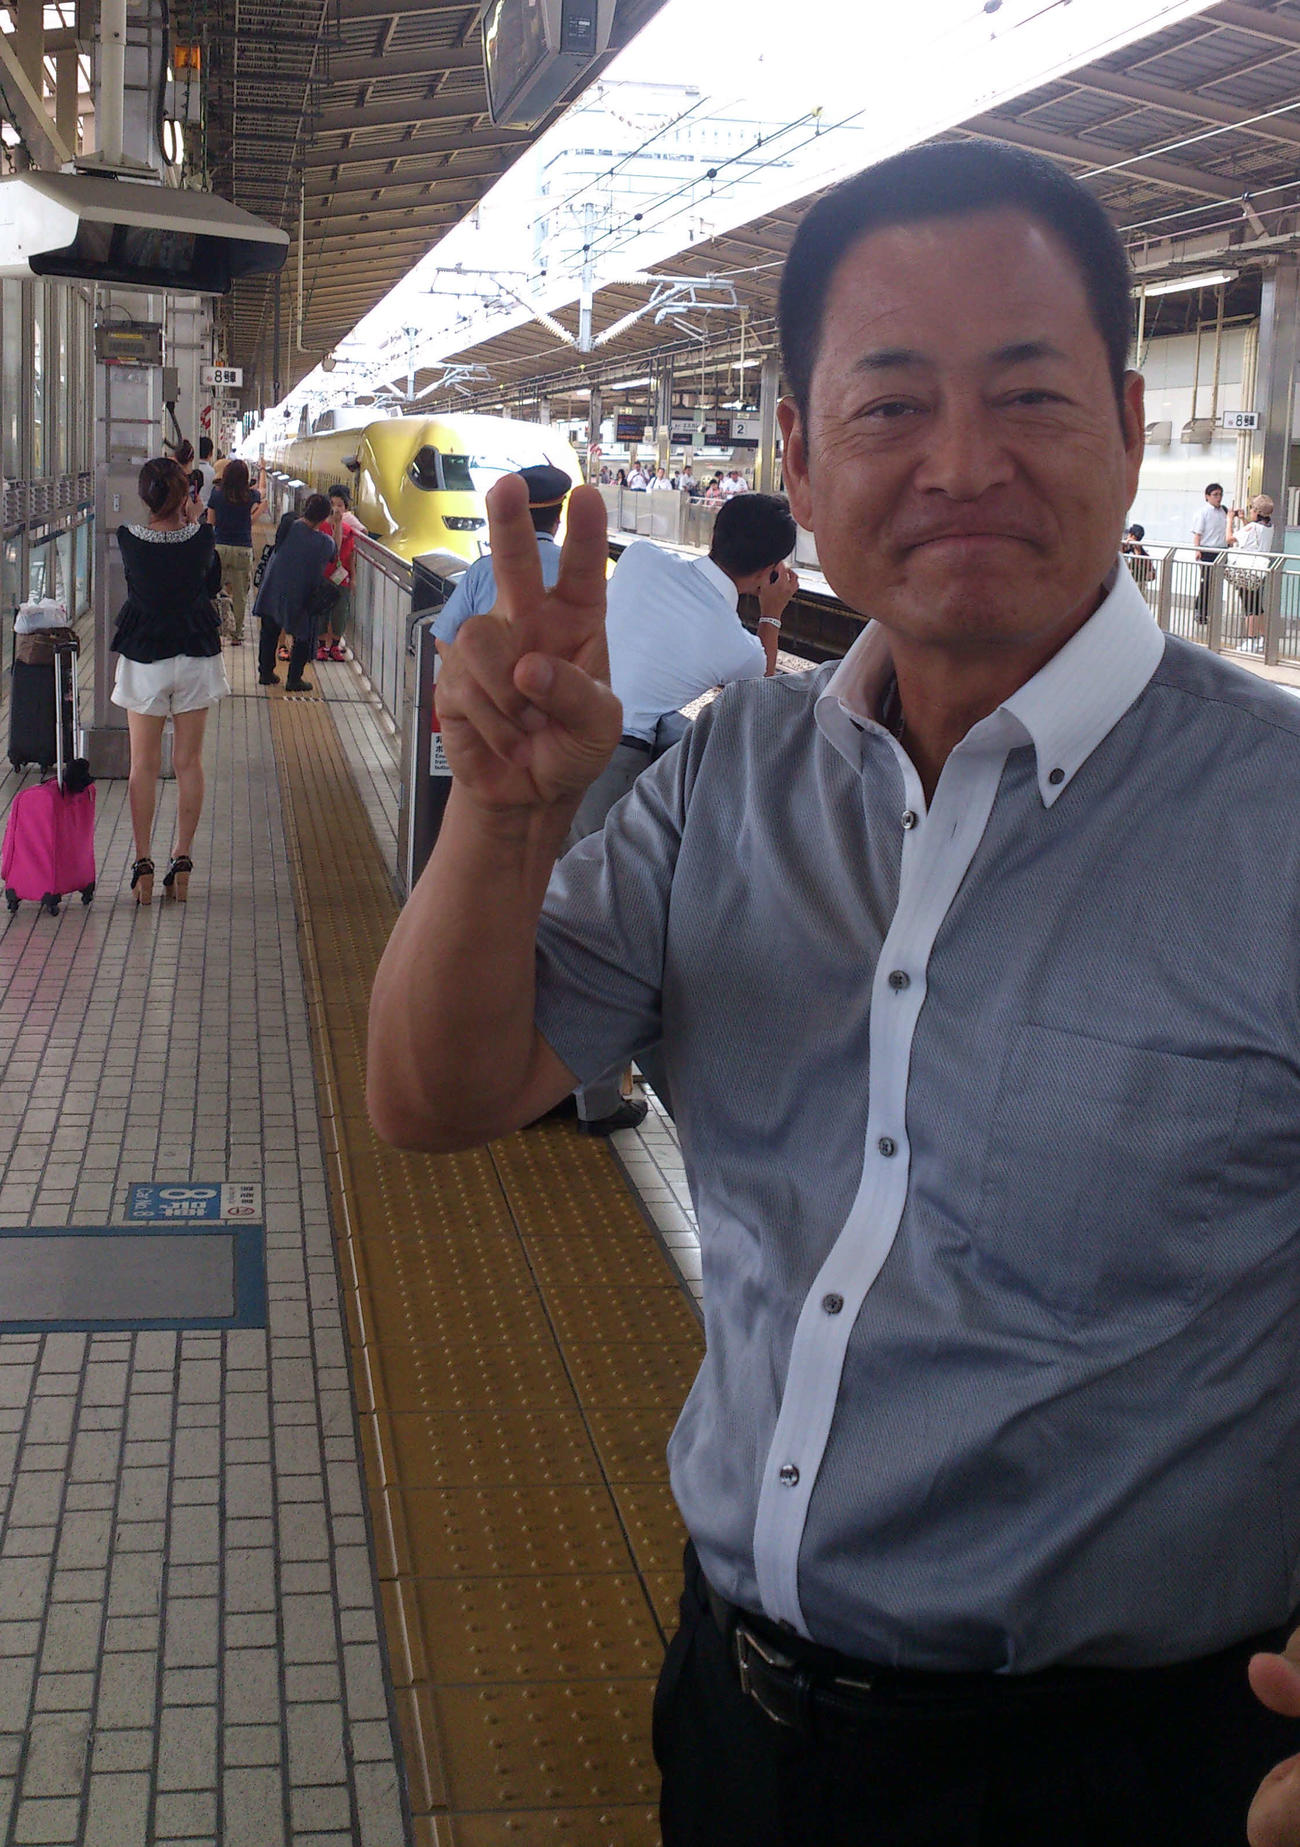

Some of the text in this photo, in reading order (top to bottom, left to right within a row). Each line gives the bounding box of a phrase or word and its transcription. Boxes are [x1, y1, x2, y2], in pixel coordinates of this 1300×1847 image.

[214, 369, 237, 383] 8号車
[1235, 414, 1255, 427] 8号車
[737, 424, 744, 434] 2
